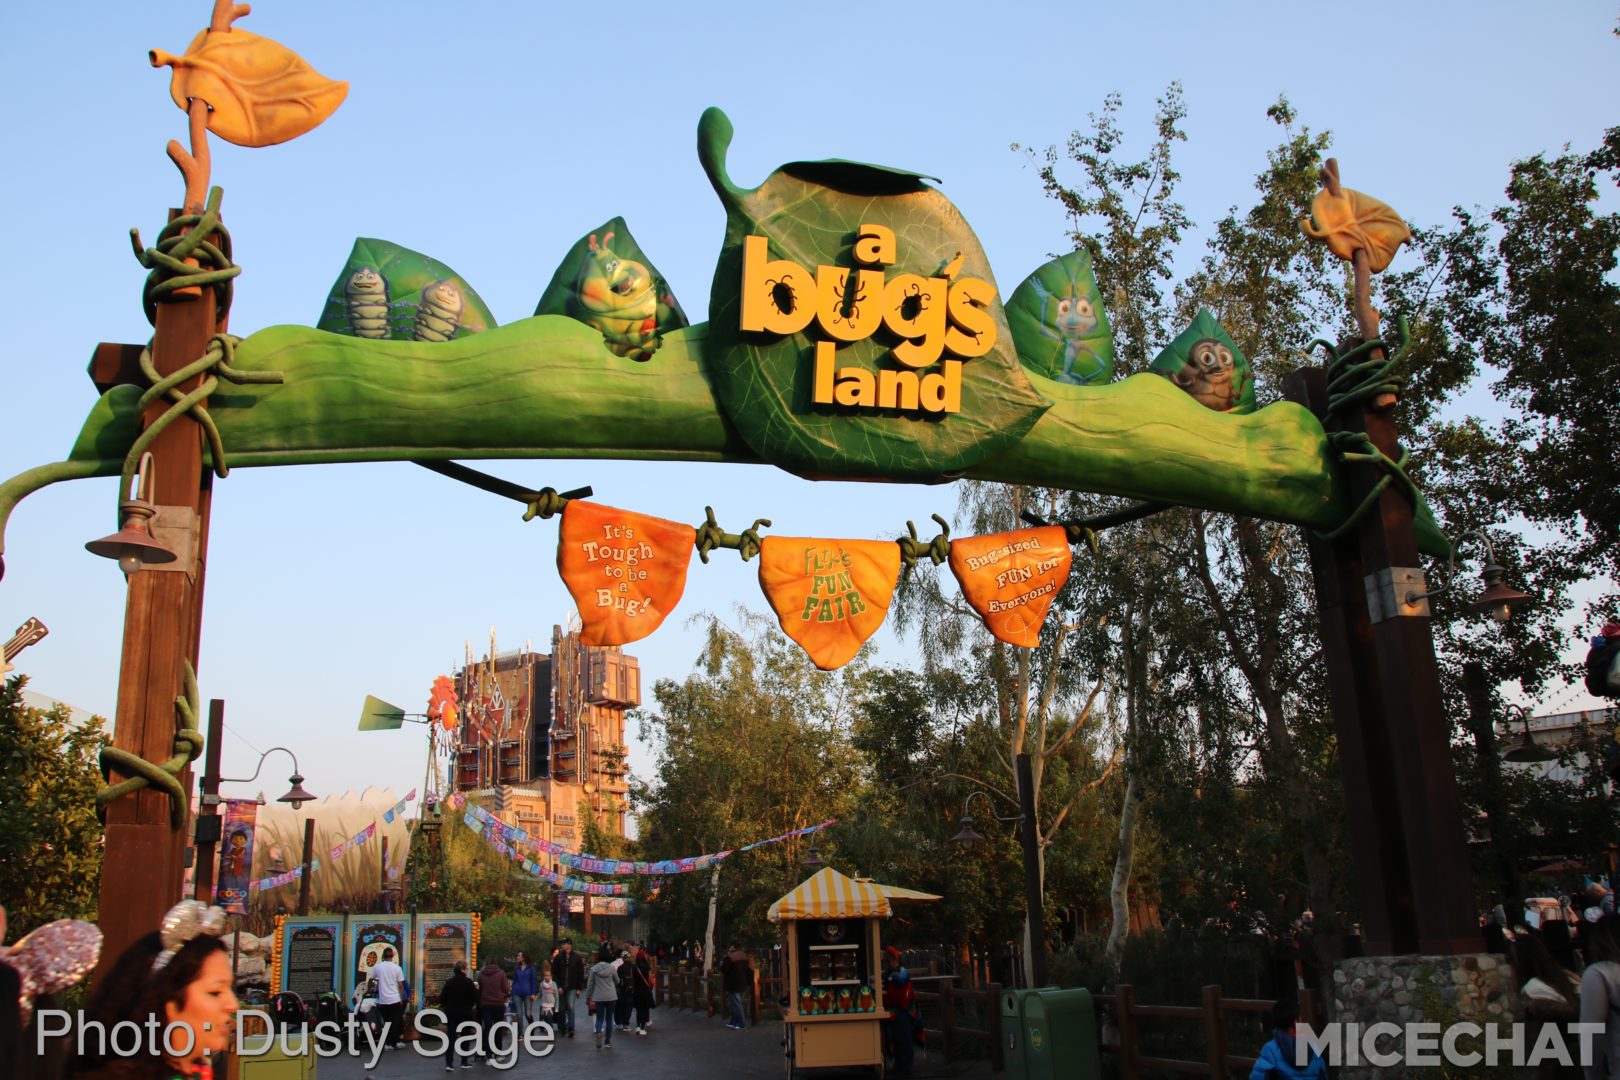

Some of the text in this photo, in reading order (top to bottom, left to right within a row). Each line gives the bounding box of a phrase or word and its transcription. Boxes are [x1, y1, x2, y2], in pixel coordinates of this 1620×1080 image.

[853, 224, 896, 266] a
[740, 235, 998, 368] bug's
[812, 341, 962, 413] land
[603, 524, 634, 540] It's
[582, 541, 654, 566] Tough
[965, 537, 1041, 571] Bug-sized
[604, 564, 647, 581] to be
[619, 582, 628, 592] a
[811, 570, 853, 595] FUN
[996, 556, 1059, 589] FUN for
[596, 588, 652, 617] Bug!
[801, 591, 866, 622] FAIR
[988, 578, 1056, 613] Everyone!
